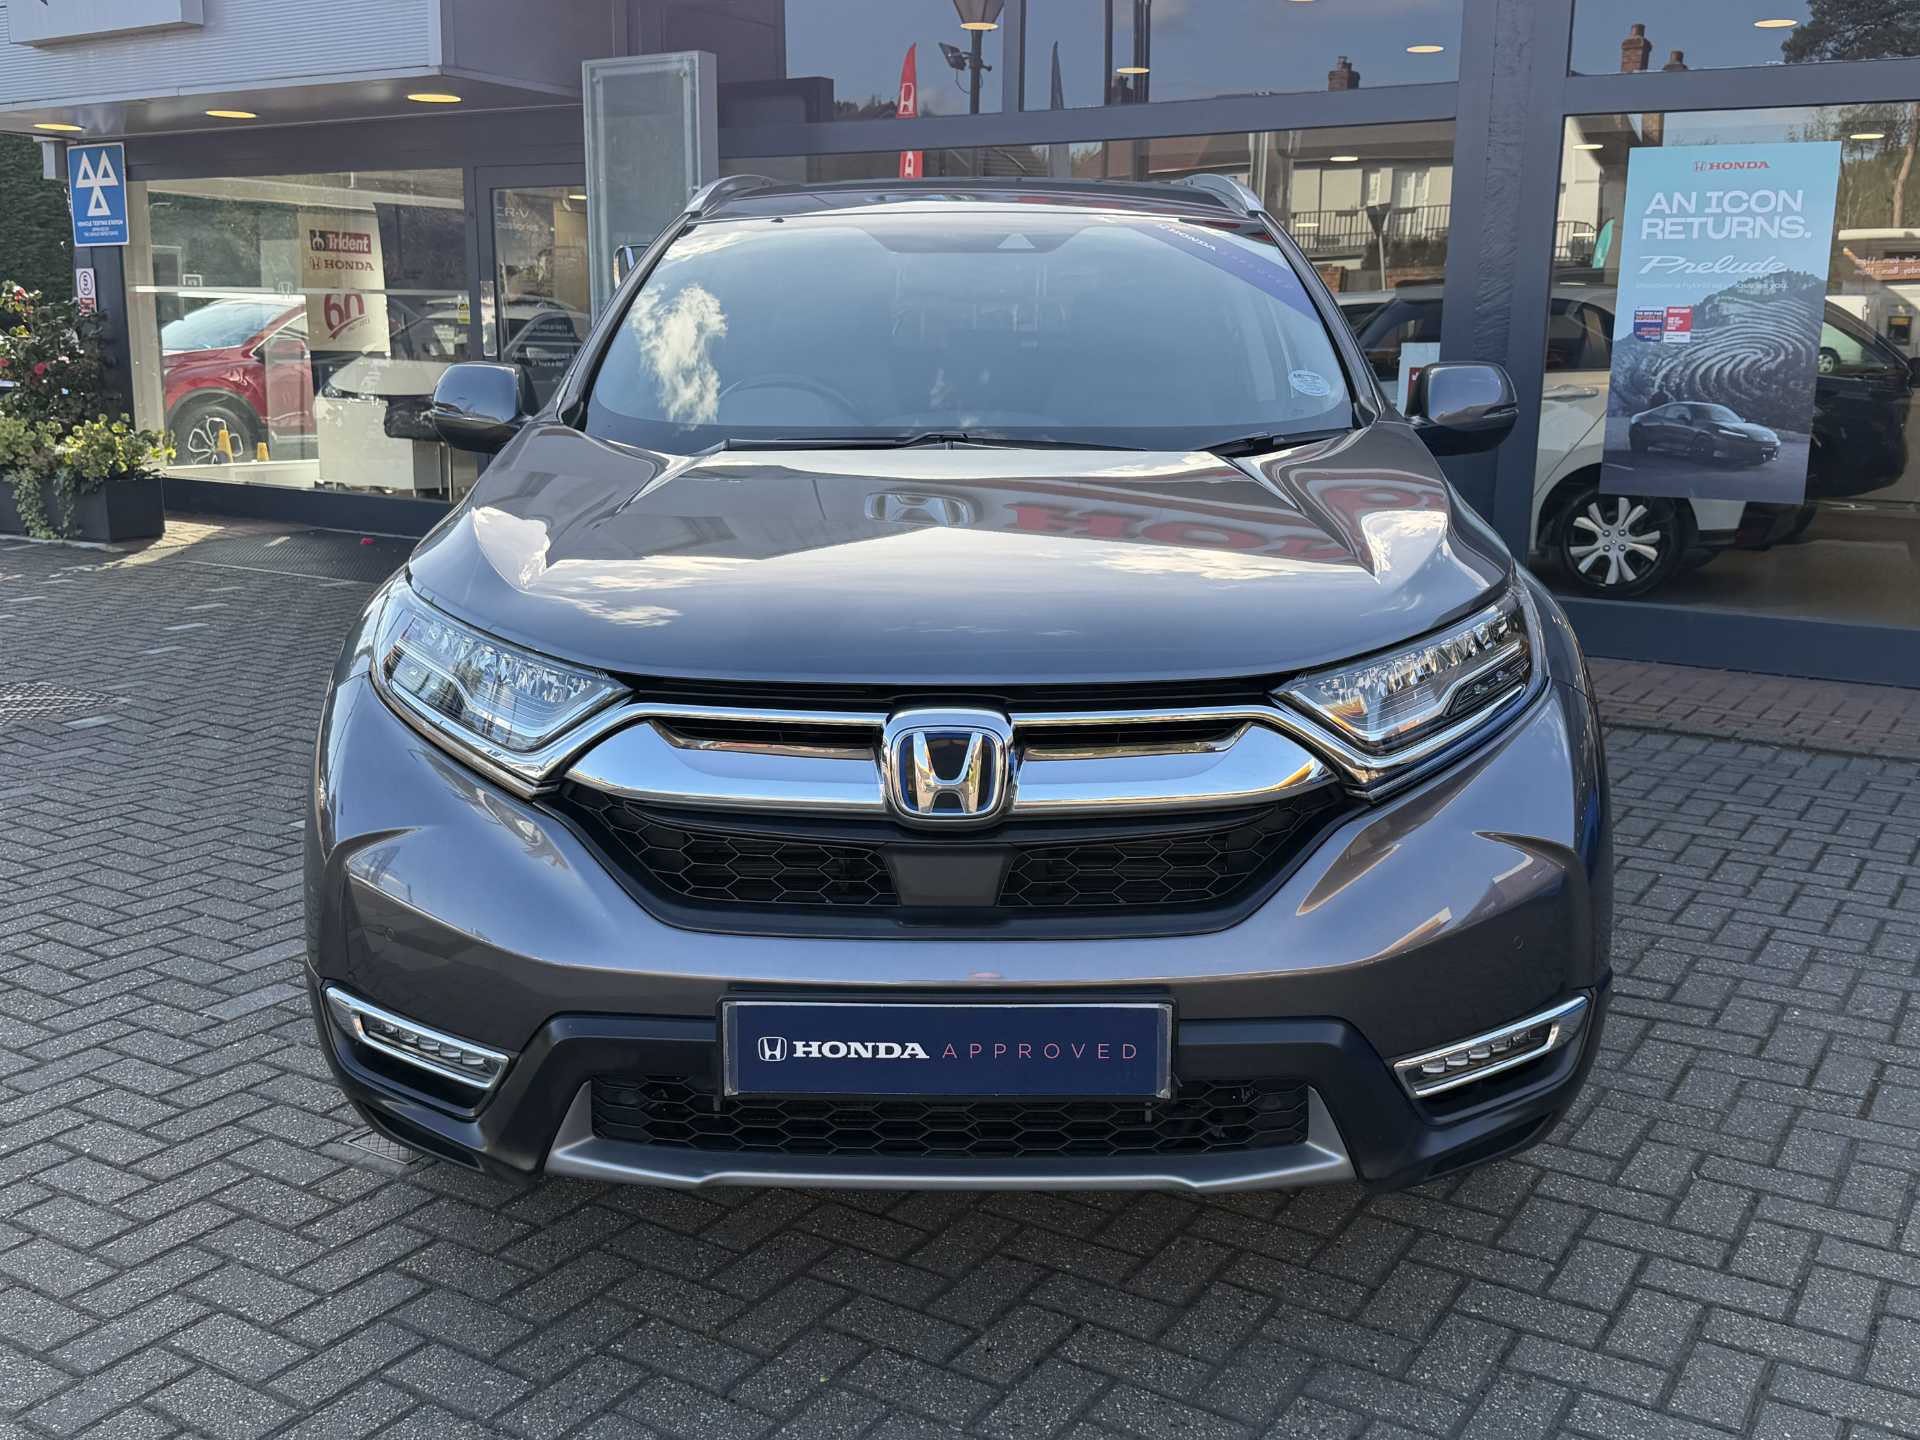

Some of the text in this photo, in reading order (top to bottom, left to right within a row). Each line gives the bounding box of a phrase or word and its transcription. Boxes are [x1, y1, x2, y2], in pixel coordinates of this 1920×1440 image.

[1708, 160, 1771, 170] HONDA
[1645, 189, 1804, 215] AN ICON
[1640, 215, 1812, 240] RETURNS.
[327, 232, 370, 252] Trident
[324, 259, 375, 272] HONDA
[1637, 254, 1789, 275] Prelude
[792, 1040, 931, 1060] HONDA
[941, 1042, 1138, 1060] APPROVED
